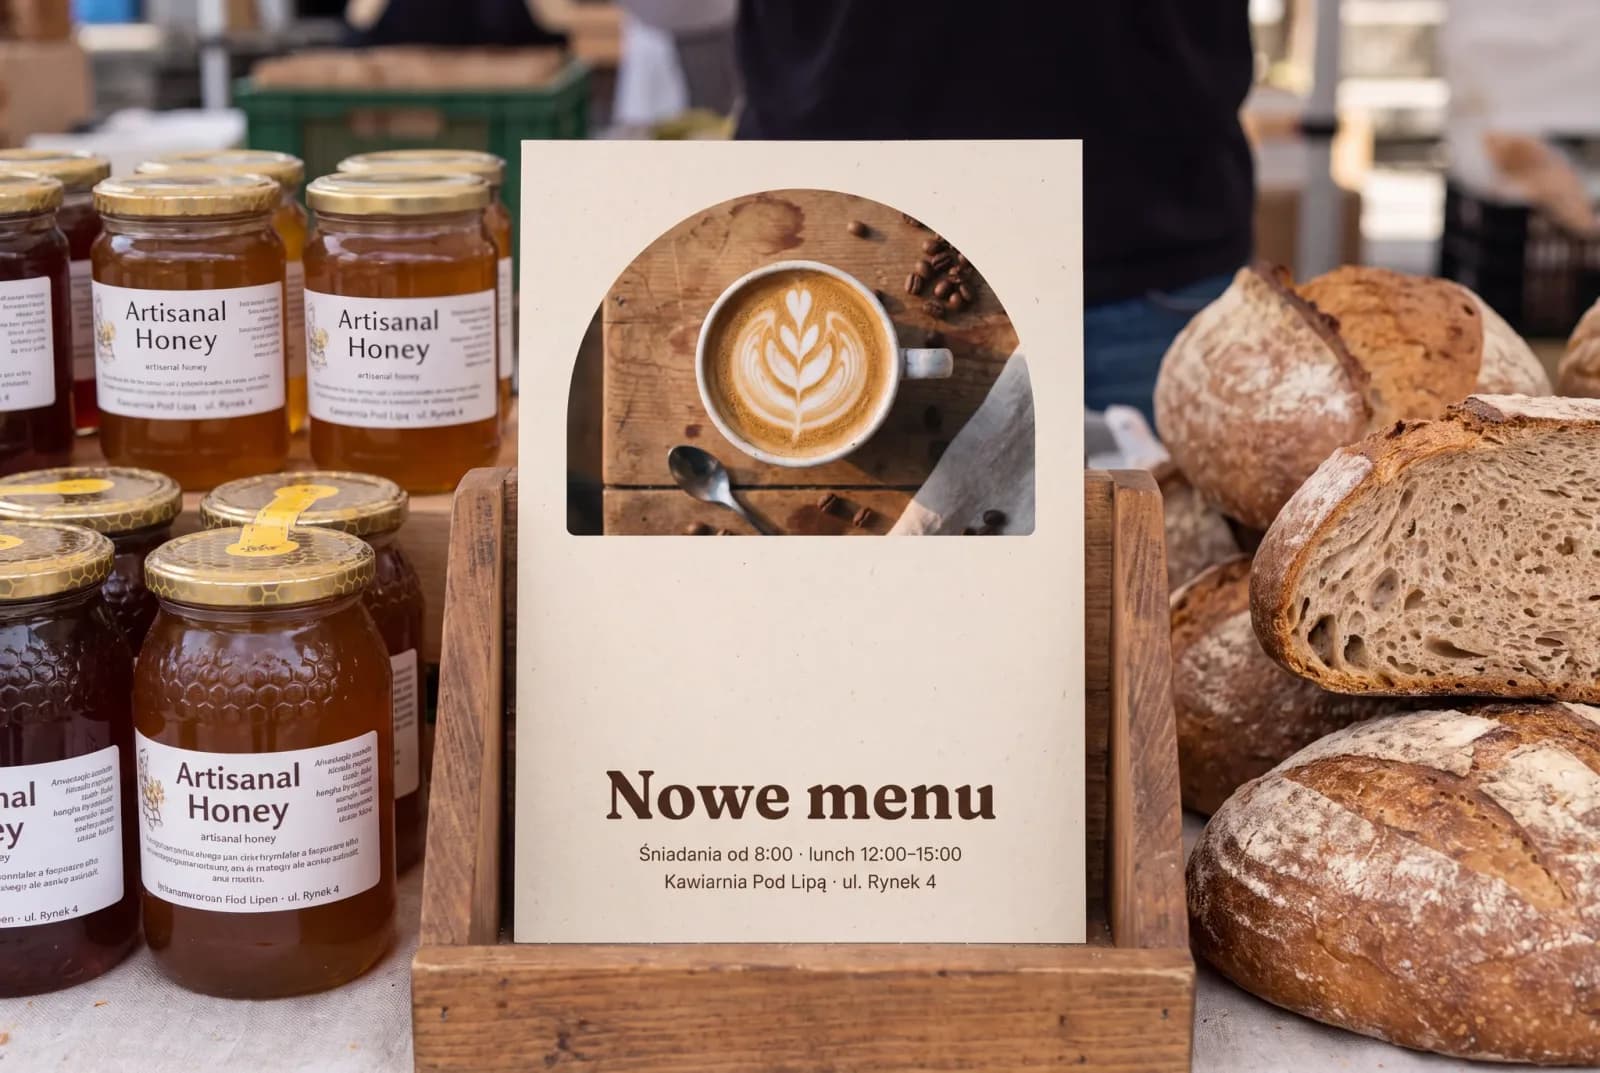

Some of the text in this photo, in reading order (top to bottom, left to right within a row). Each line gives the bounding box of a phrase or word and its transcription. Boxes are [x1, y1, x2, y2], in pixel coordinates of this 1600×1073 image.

[125, 300, 227, 323] Artisanal
[338, 309, 439, 332] Artisanal
[136, 328, 218, 356] Honey
[349, 336, 430, 366] Honey
[176, 761, 300, 791] Artisanal
[606, 770, 997, 821] Nowe menu
[188, 793, 290, 831] Honey
[200, 833, 277, 846] artisanal honey
[639, 842, 722, 862] Śniadania
[727, 846, 749, 862] od
[754, 846, 793, 862] 8:00
[808, 846, 855, 862] lunch
[303, 886, 332, 902] Rynek
[332, 884, 340, 894] 4
[664, 873, 747, 890] Kawiarnia
[753, 874, 786, 890] Pod
[790, 874, 827, 893] Lipą
[842, 874, 863, 890] ul.
[867, 874, 920, 893] Rynek
[926, 874, 937, 890] 4
[40, 905, 71, 921] Rynek
[71, 904, 79, 914] 4
